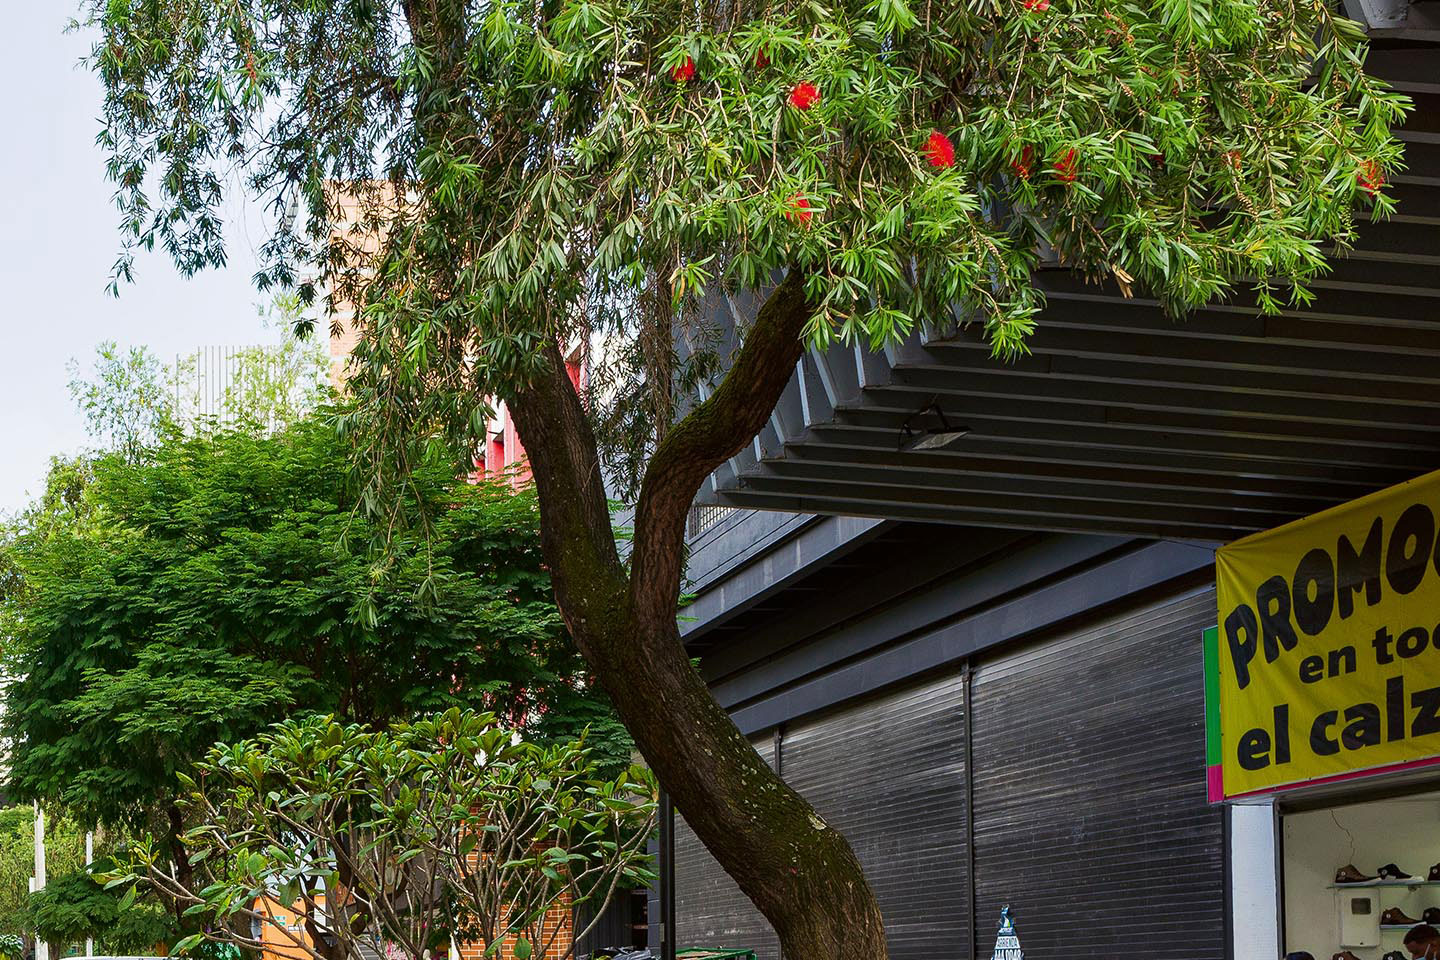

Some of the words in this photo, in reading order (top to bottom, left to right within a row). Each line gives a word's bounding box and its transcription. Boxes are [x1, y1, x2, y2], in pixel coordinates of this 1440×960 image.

[1224, 503, 1440, 690] PROMO
[1299, 645, 1357, 684] en
[1237, 704, 1291, 770] el
